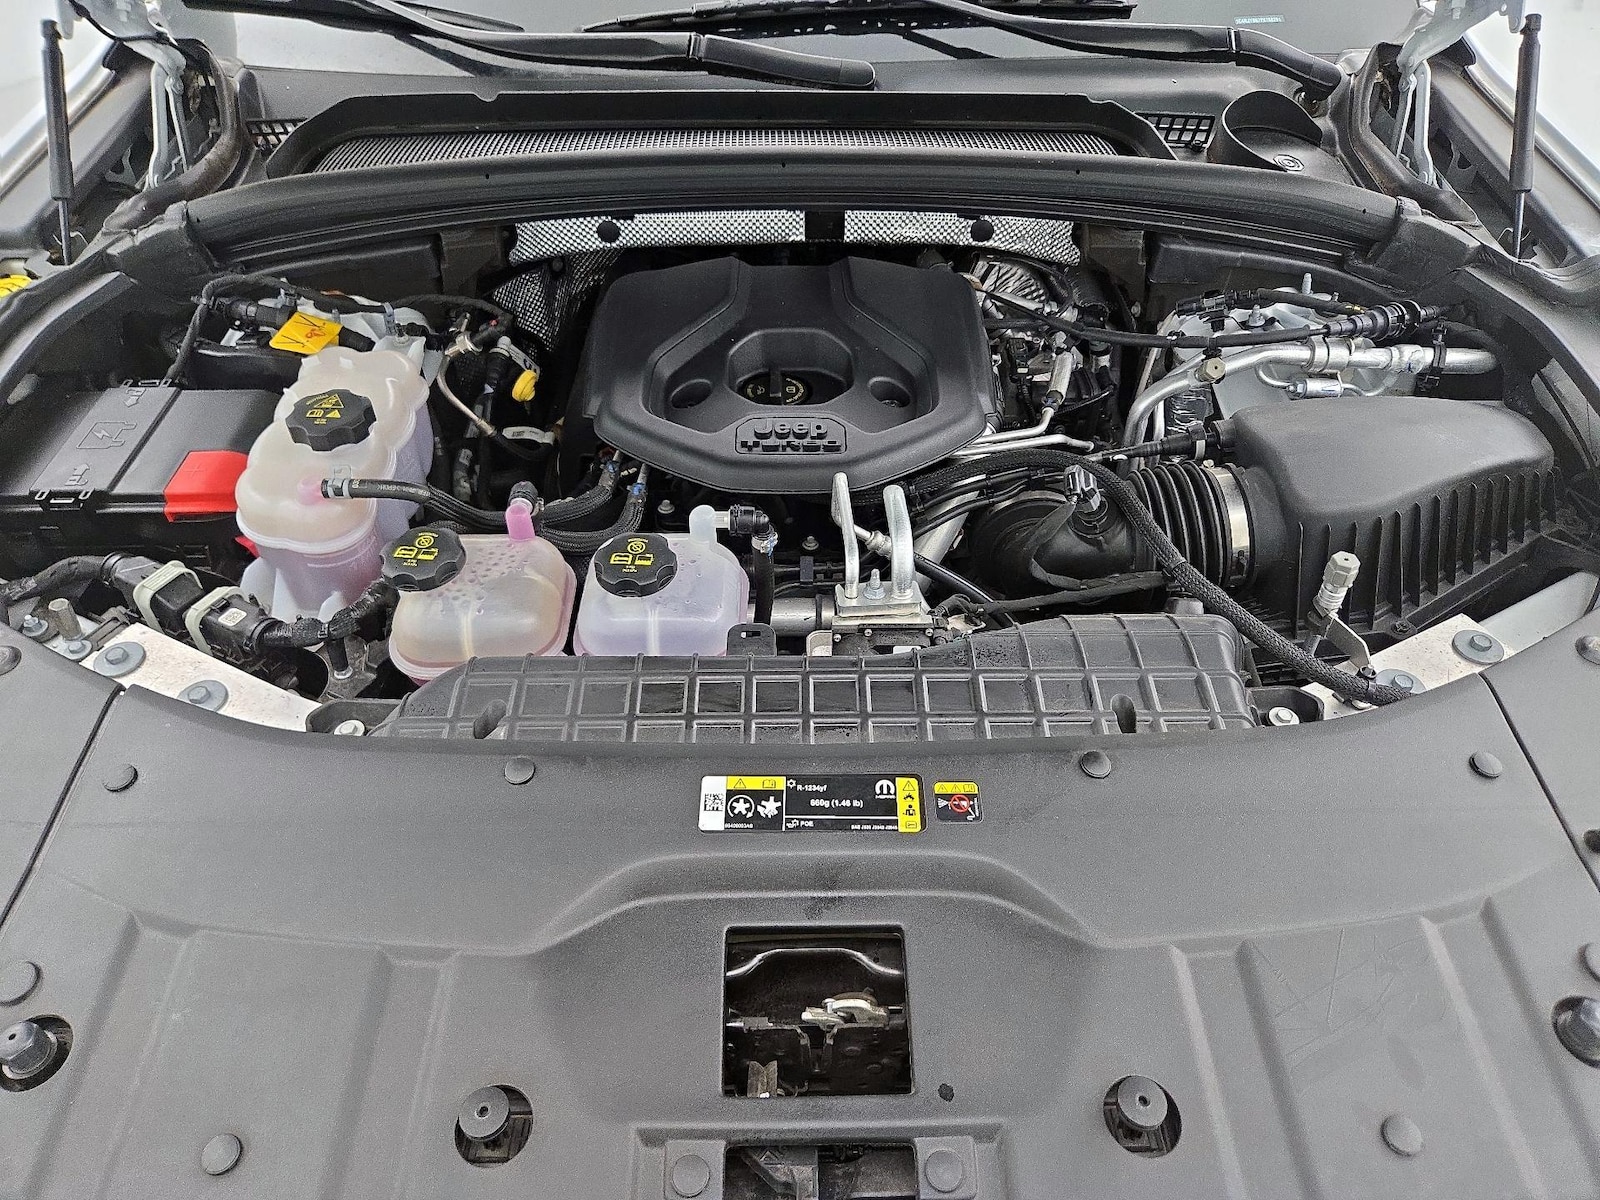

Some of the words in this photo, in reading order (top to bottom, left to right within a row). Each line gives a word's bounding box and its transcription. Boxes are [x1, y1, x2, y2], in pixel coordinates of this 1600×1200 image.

[753, 419, 828, 440] Jeep
[796, 784, 828, 793] R-1234yf
[810, 798, 830, 808] 660g
[852, 798, 864, 809] lb)
[800, 820, 814, 828] POE
